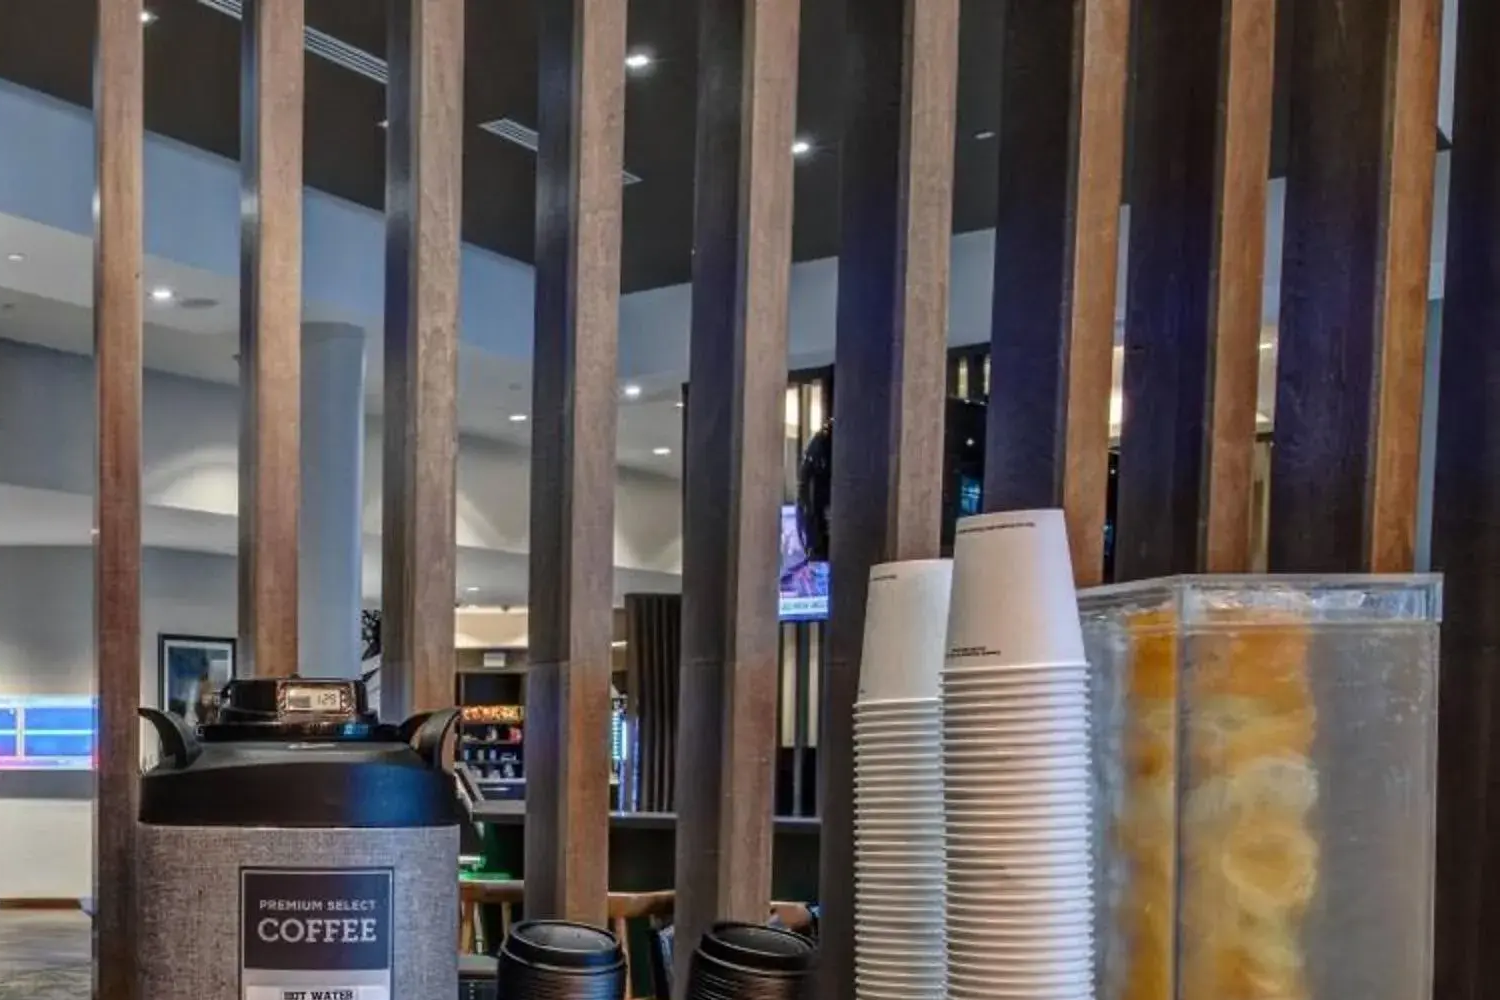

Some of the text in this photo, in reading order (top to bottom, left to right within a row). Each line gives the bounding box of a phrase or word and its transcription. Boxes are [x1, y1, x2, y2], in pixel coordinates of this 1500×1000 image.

[259, 899, 376, 911] PREMIUM SELECT
[257, 917, 377, 943] COFFEE
[311, 991, 353, 1000] WATER
